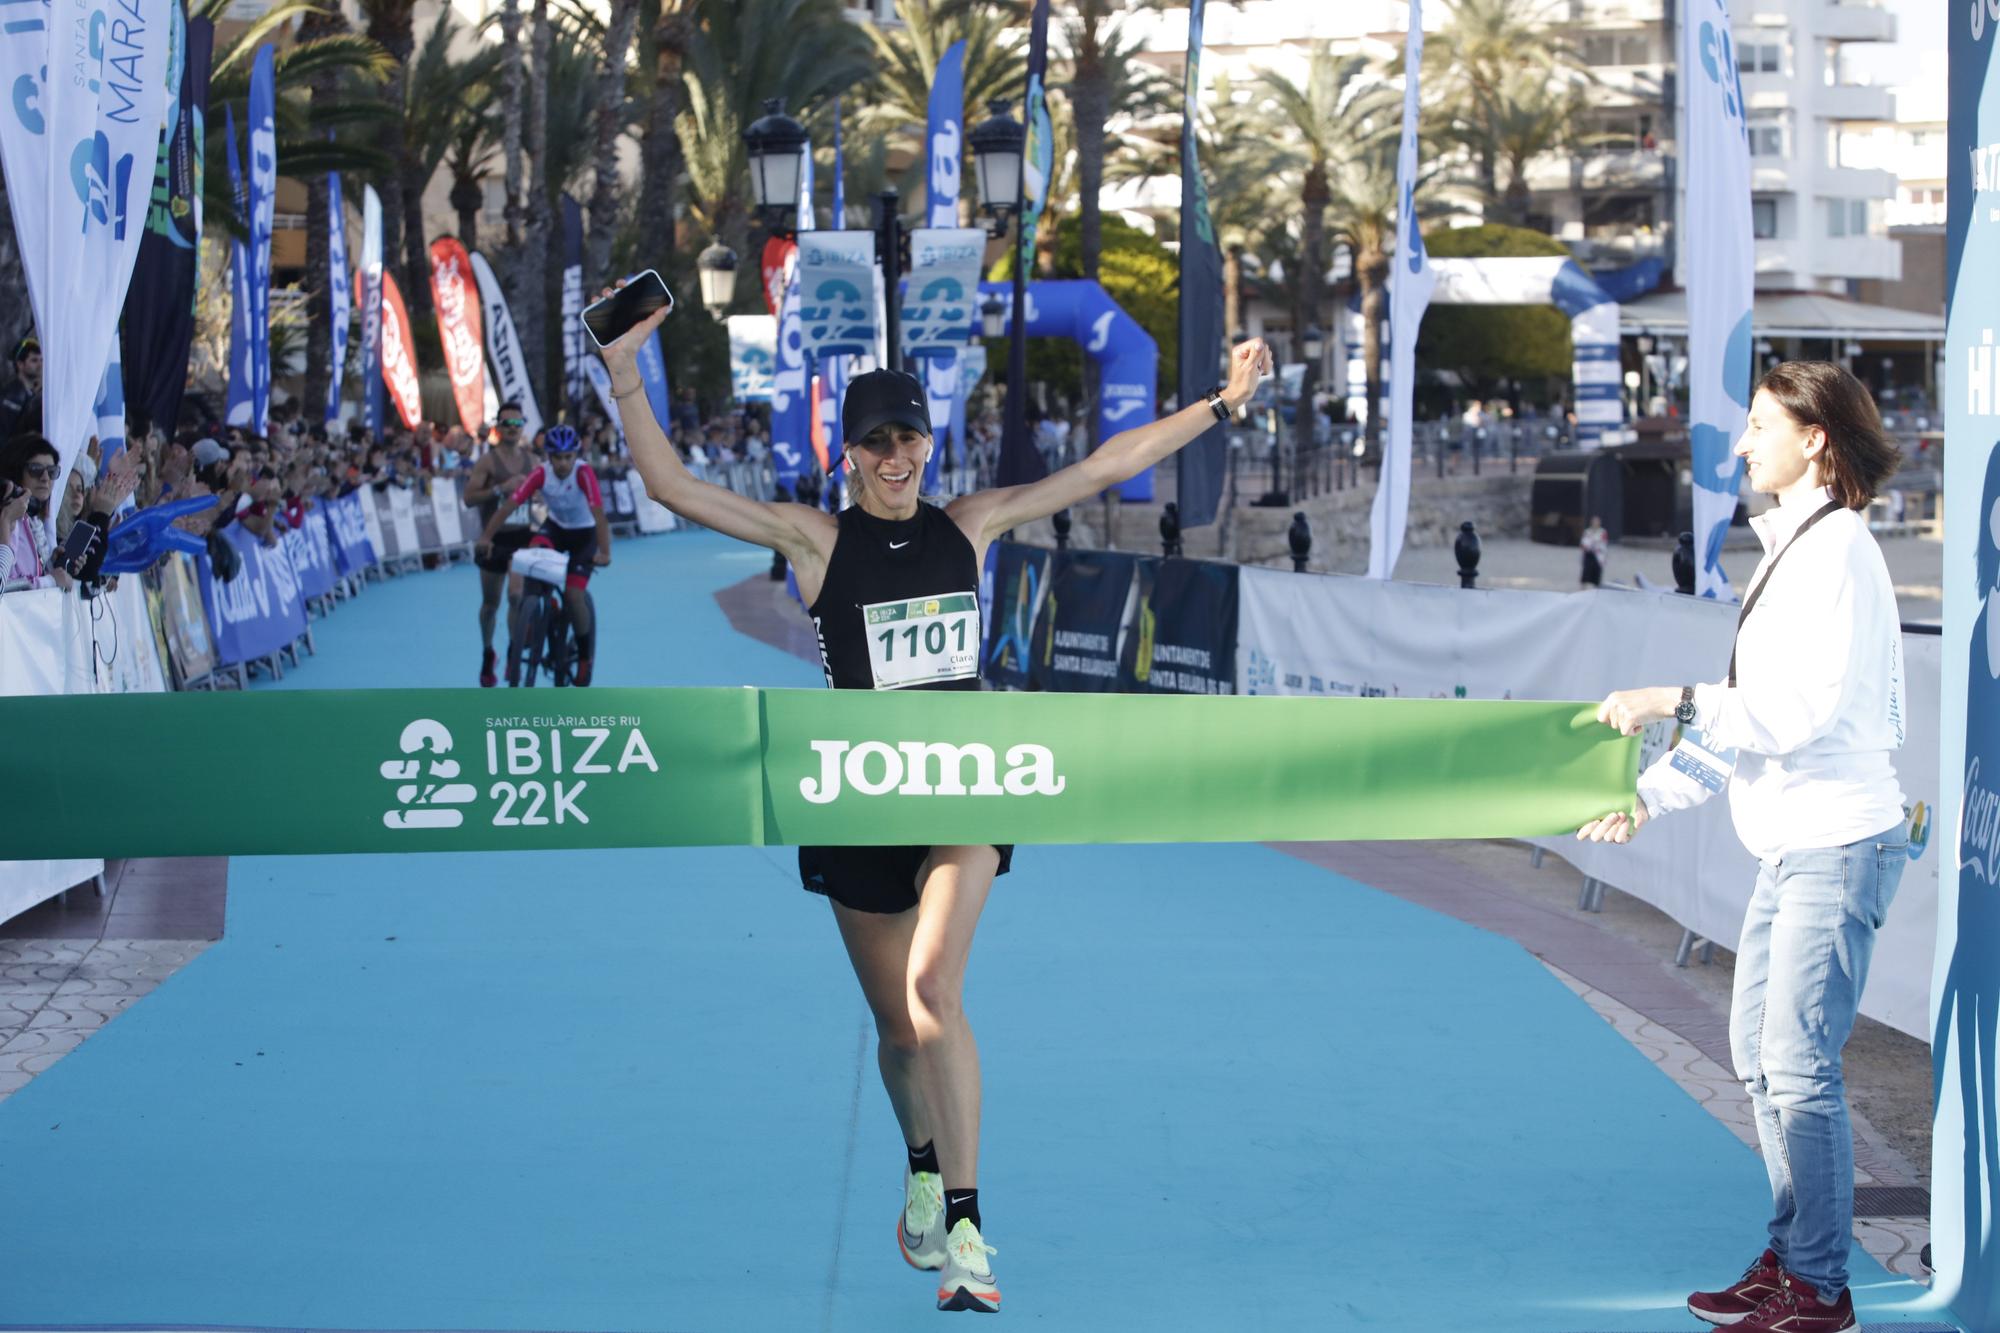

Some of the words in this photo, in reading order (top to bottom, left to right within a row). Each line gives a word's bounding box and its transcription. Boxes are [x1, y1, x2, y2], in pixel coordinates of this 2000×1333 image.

[74, 18, 87, 88] SANTA
[878, 618, 966, 662] 1101
[950, 653, 974, 664] Clara
[486, 717, 529, 728] SANTA
[533, 714, 587, 728] EULÀRIA
[591, 716, 616, 727] DES
[620, 715, 641, 727] RIU
[486, 728, 659, 776] IBIZA
[489, 780, 590, 826] 22K
